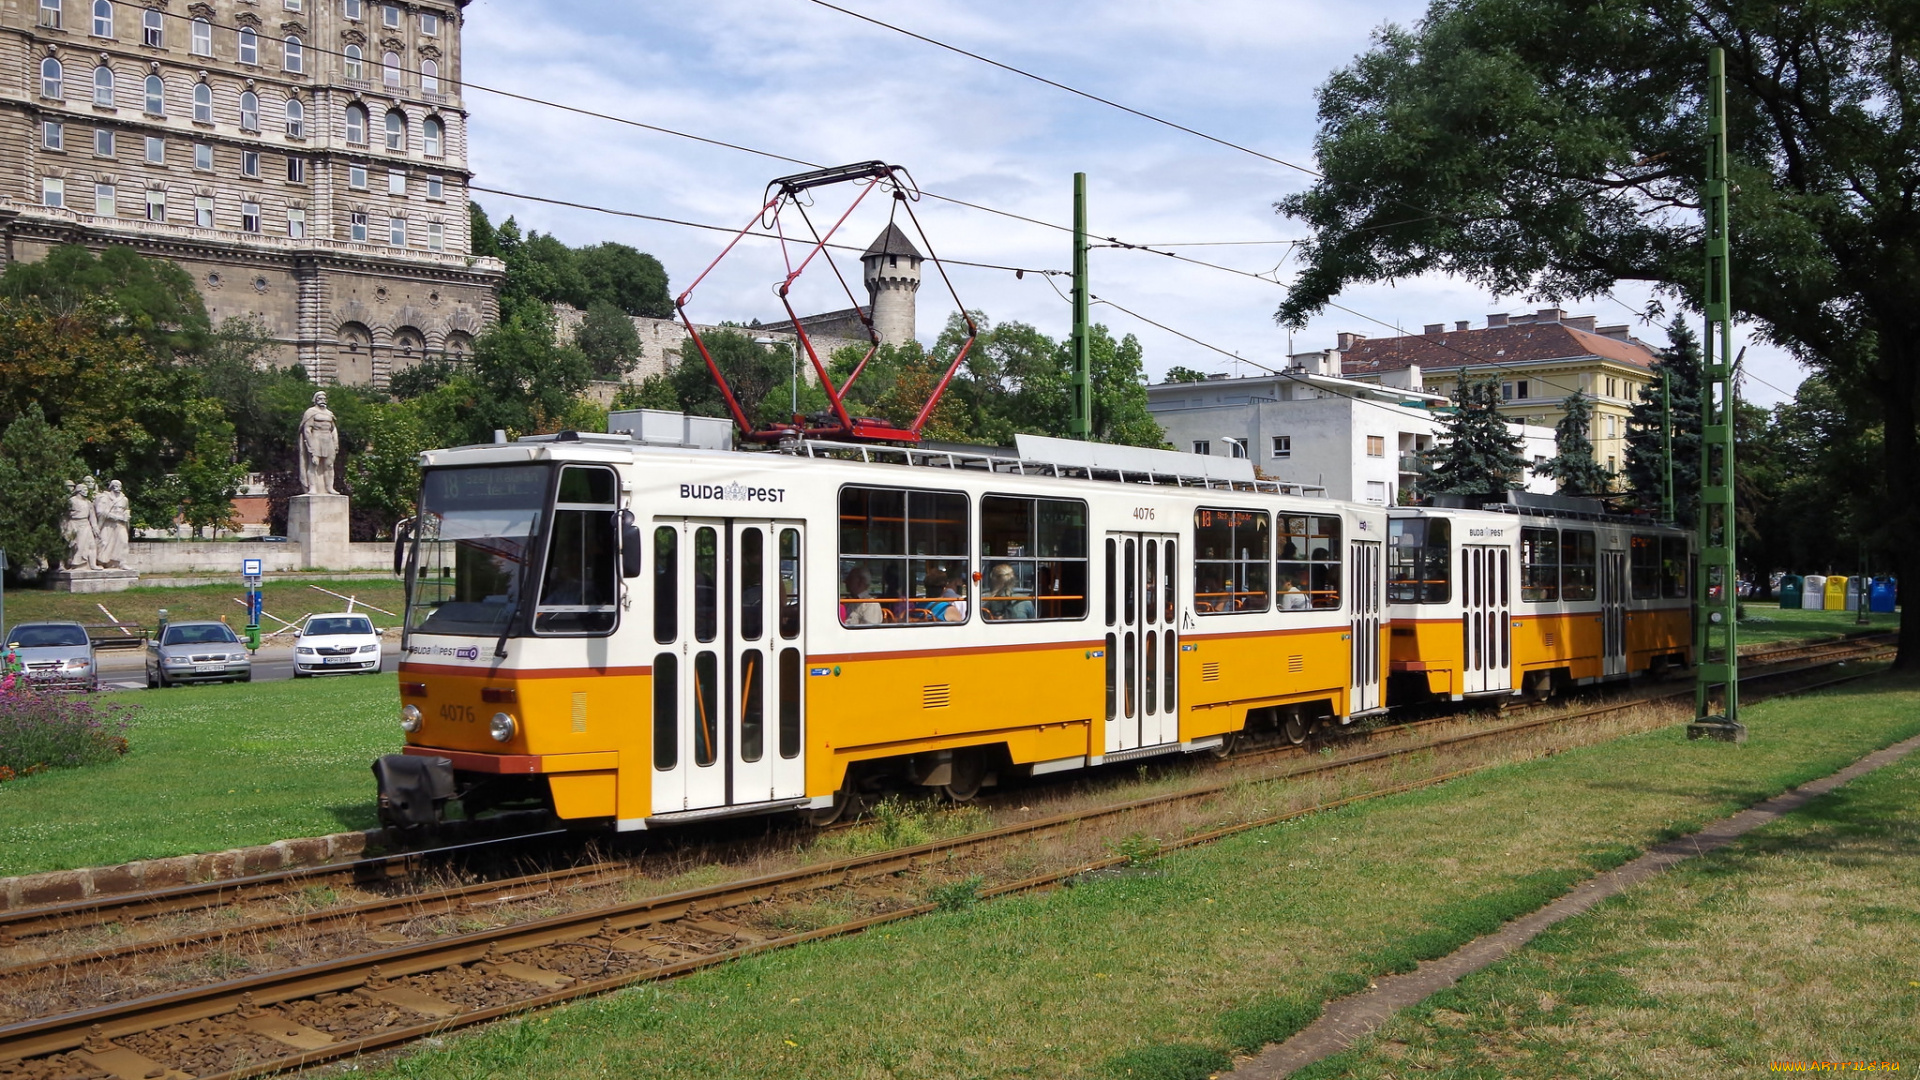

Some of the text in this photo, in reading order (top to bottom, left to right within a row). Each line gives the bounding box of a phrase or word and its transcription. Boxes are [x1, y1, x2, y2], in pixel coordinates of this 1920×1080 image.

[442, 473, 459, 498] 18
[1133, 507, 1155, 520] 4076
[440, 703, 476, 723] 4076
